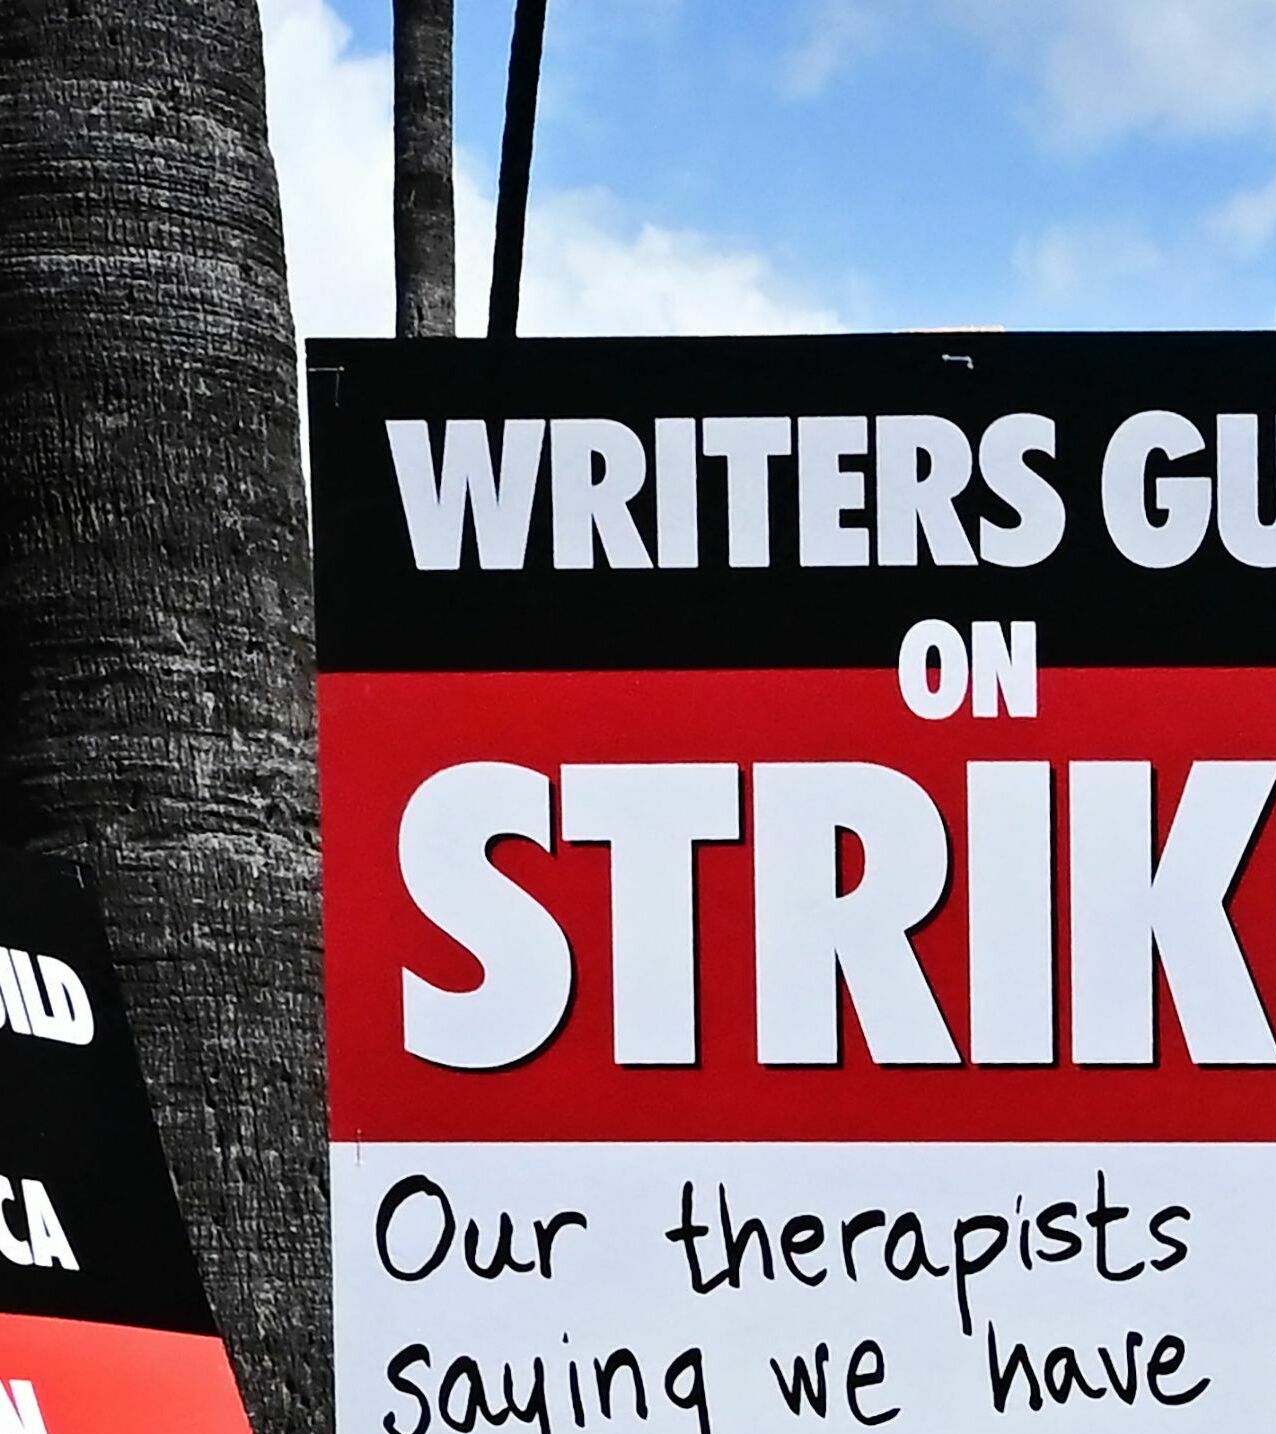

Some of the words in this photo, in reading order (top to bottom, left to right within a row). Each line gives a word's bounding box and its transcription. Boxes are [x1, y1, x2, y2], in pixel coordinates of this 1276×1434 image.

[385, 413, 1065, 570] WRITERS
[898, 619, 1037, 719] ON
[0, 947, 94, 1044] ILD
[376, 1175, 587, 1281] Our
[666, 1171, 1190, 1335] therapists
[770, 1340, 900, 1425] we
[988, 1321, 1210, 1413] have
